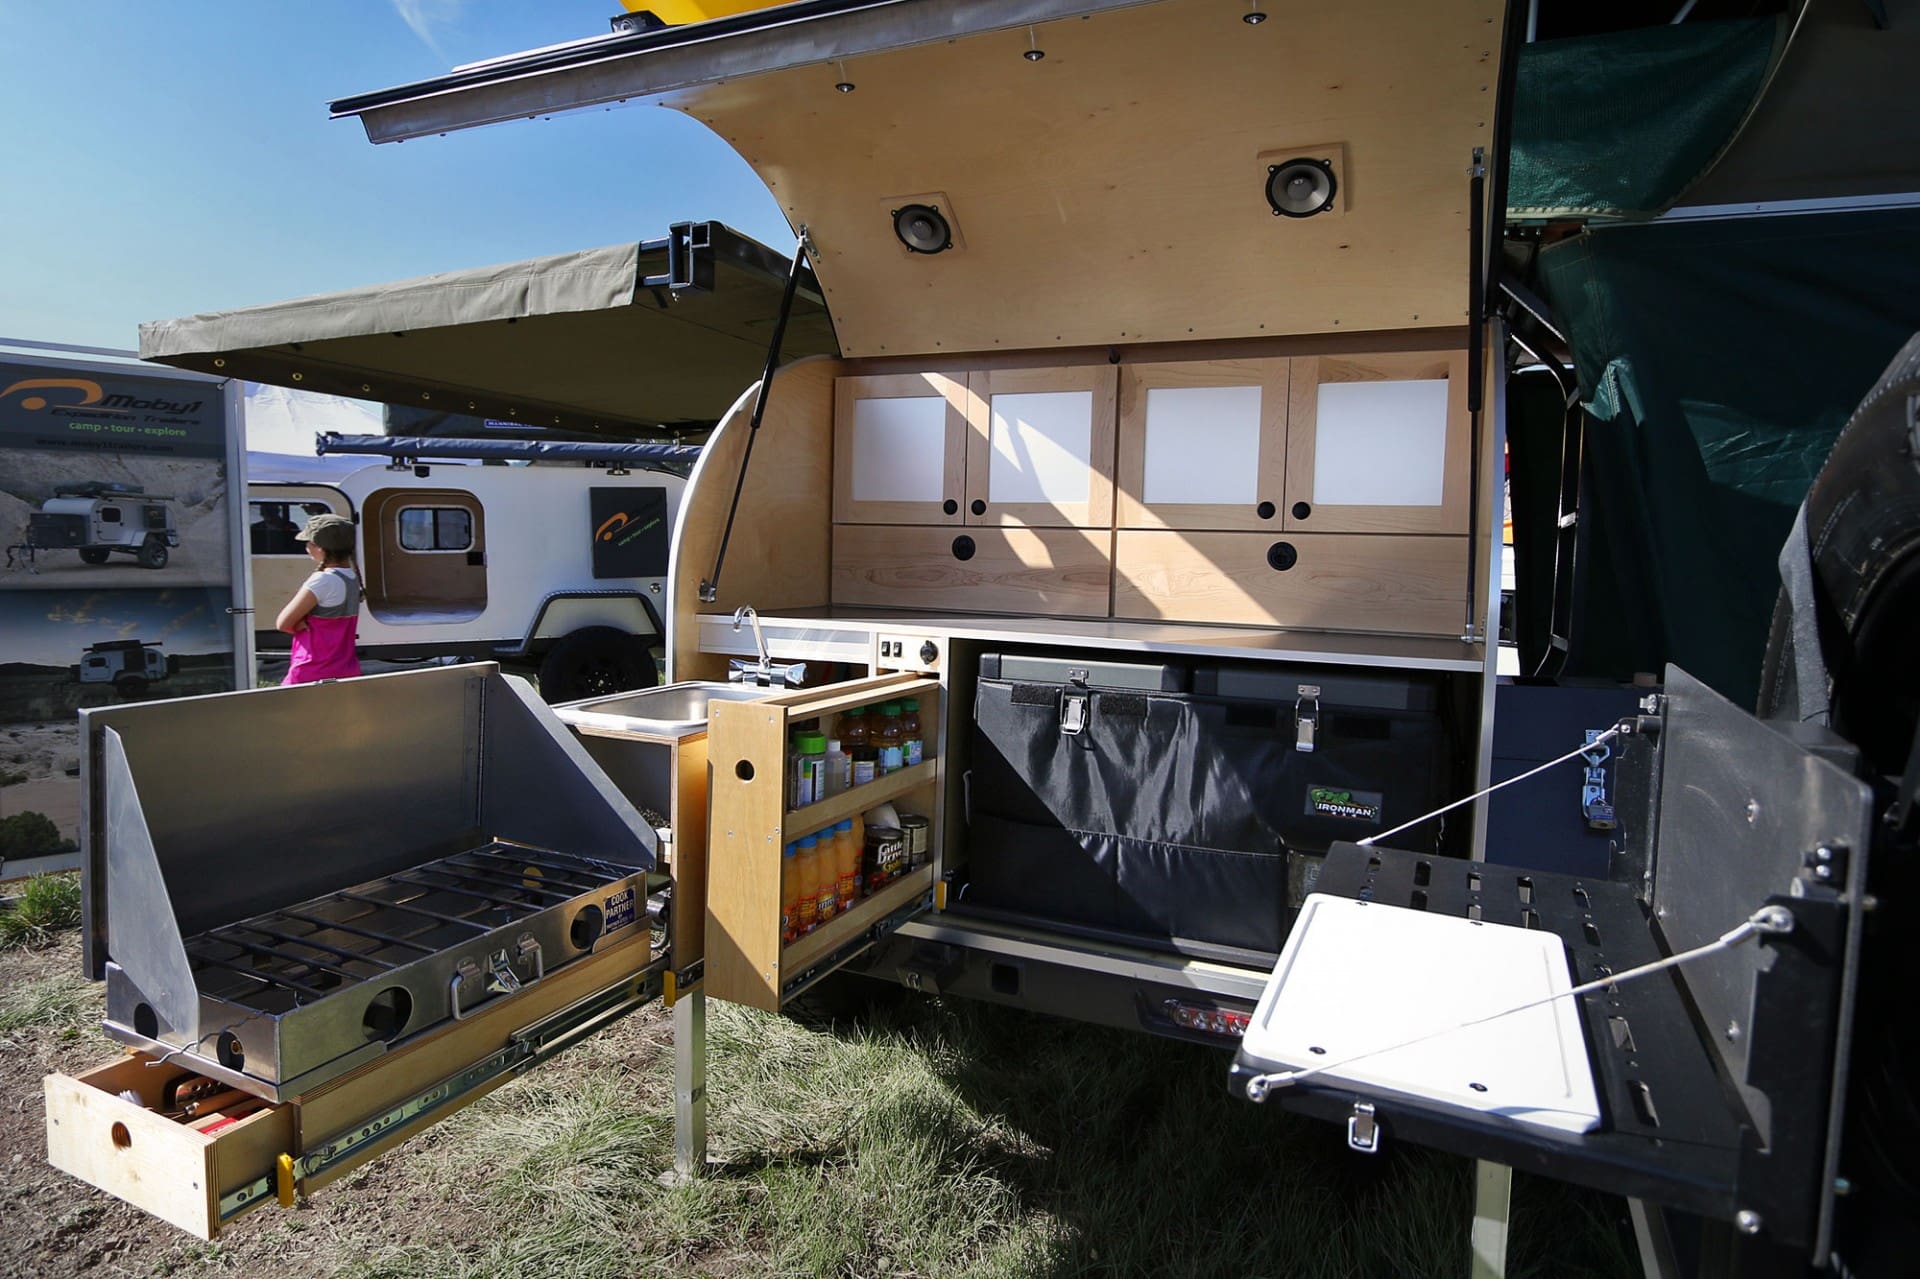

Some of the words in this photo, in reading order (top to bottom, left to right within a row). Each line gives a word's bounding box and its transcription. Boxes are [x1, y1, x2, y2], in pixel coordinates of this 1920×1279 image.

[101, 393, 203, 414] Moby1
[69, 421, 102, 432] camp
[110, 423, 136, 433] tour
[143, 427, 187, 437] explore
[1318, 802, 1371, 816] IRONMAN
[611, 891, 629, 906] COOK
[606, 899, 634, 919] PARTNER
